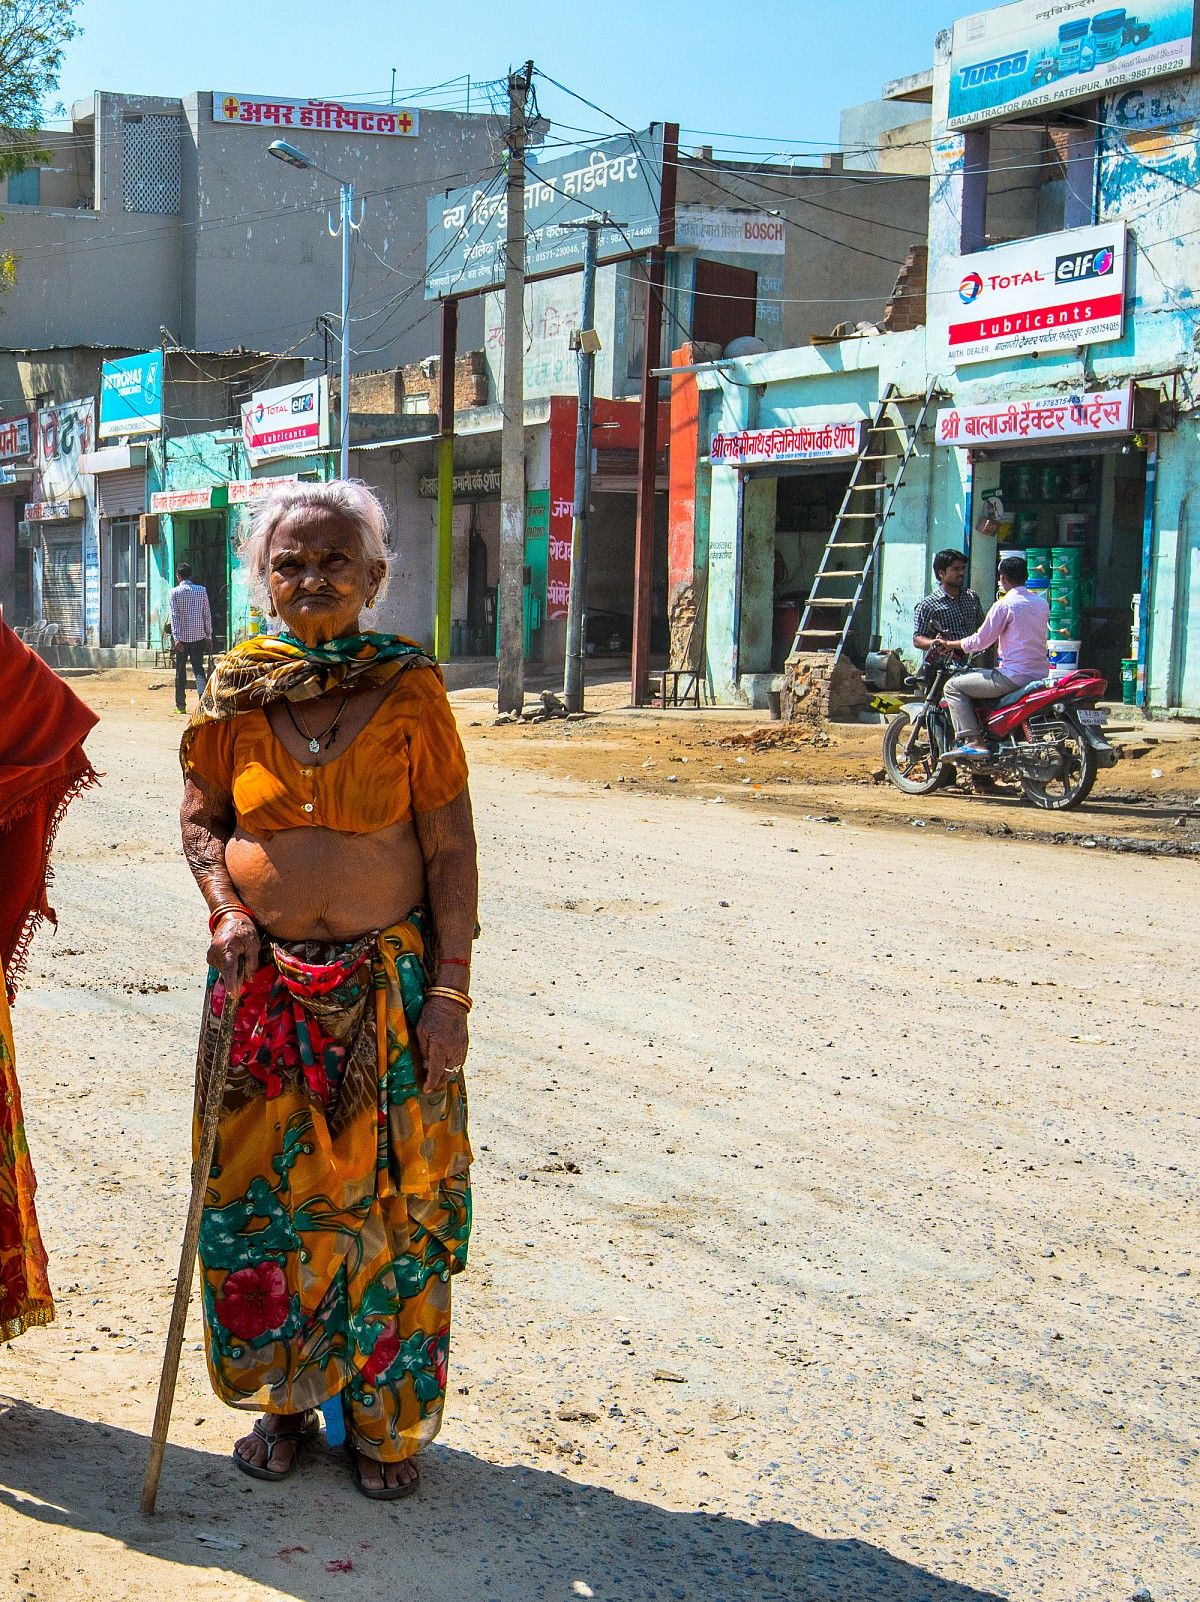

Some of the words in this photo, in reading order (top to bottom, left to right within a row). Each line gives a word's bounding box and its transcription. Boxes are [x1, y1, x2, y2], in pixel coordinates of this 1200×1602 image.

[960, 50, 1029, 88] TURBO
[239, 101, 295, 125] अमर
[298, 100, 399, 133] हॉस्पिटल
[950, 112, 979, 127] BALAJI
[980, 101, 1020, 119] TRACTOR
[744, 222, 783, 240] BOSCH
[988, 270, 1045, 291] TOTAL
[1057, 253, 1093, 280] elf
[980, 306, 1092, 336] Lubricants
[104, 367, 142, 391] PETRONAS
[267, 405, 289, 415] TOTAL
[293, 398, 305, 412] elf
[941, 411, 961, 441] श्री
[964, 404, 1019, 439] बालाजी
[1019, 402, 1068, 436] ट्रैक्टर
[263, 429, 307, 443] Lubricants
[711, 433, 723, 458] श्री
[723, 431, 765, 459] लक्ष्मीनाथ
[816, 424, 833, 448] वर्क
[833, 424, 856, 449] शॉप
